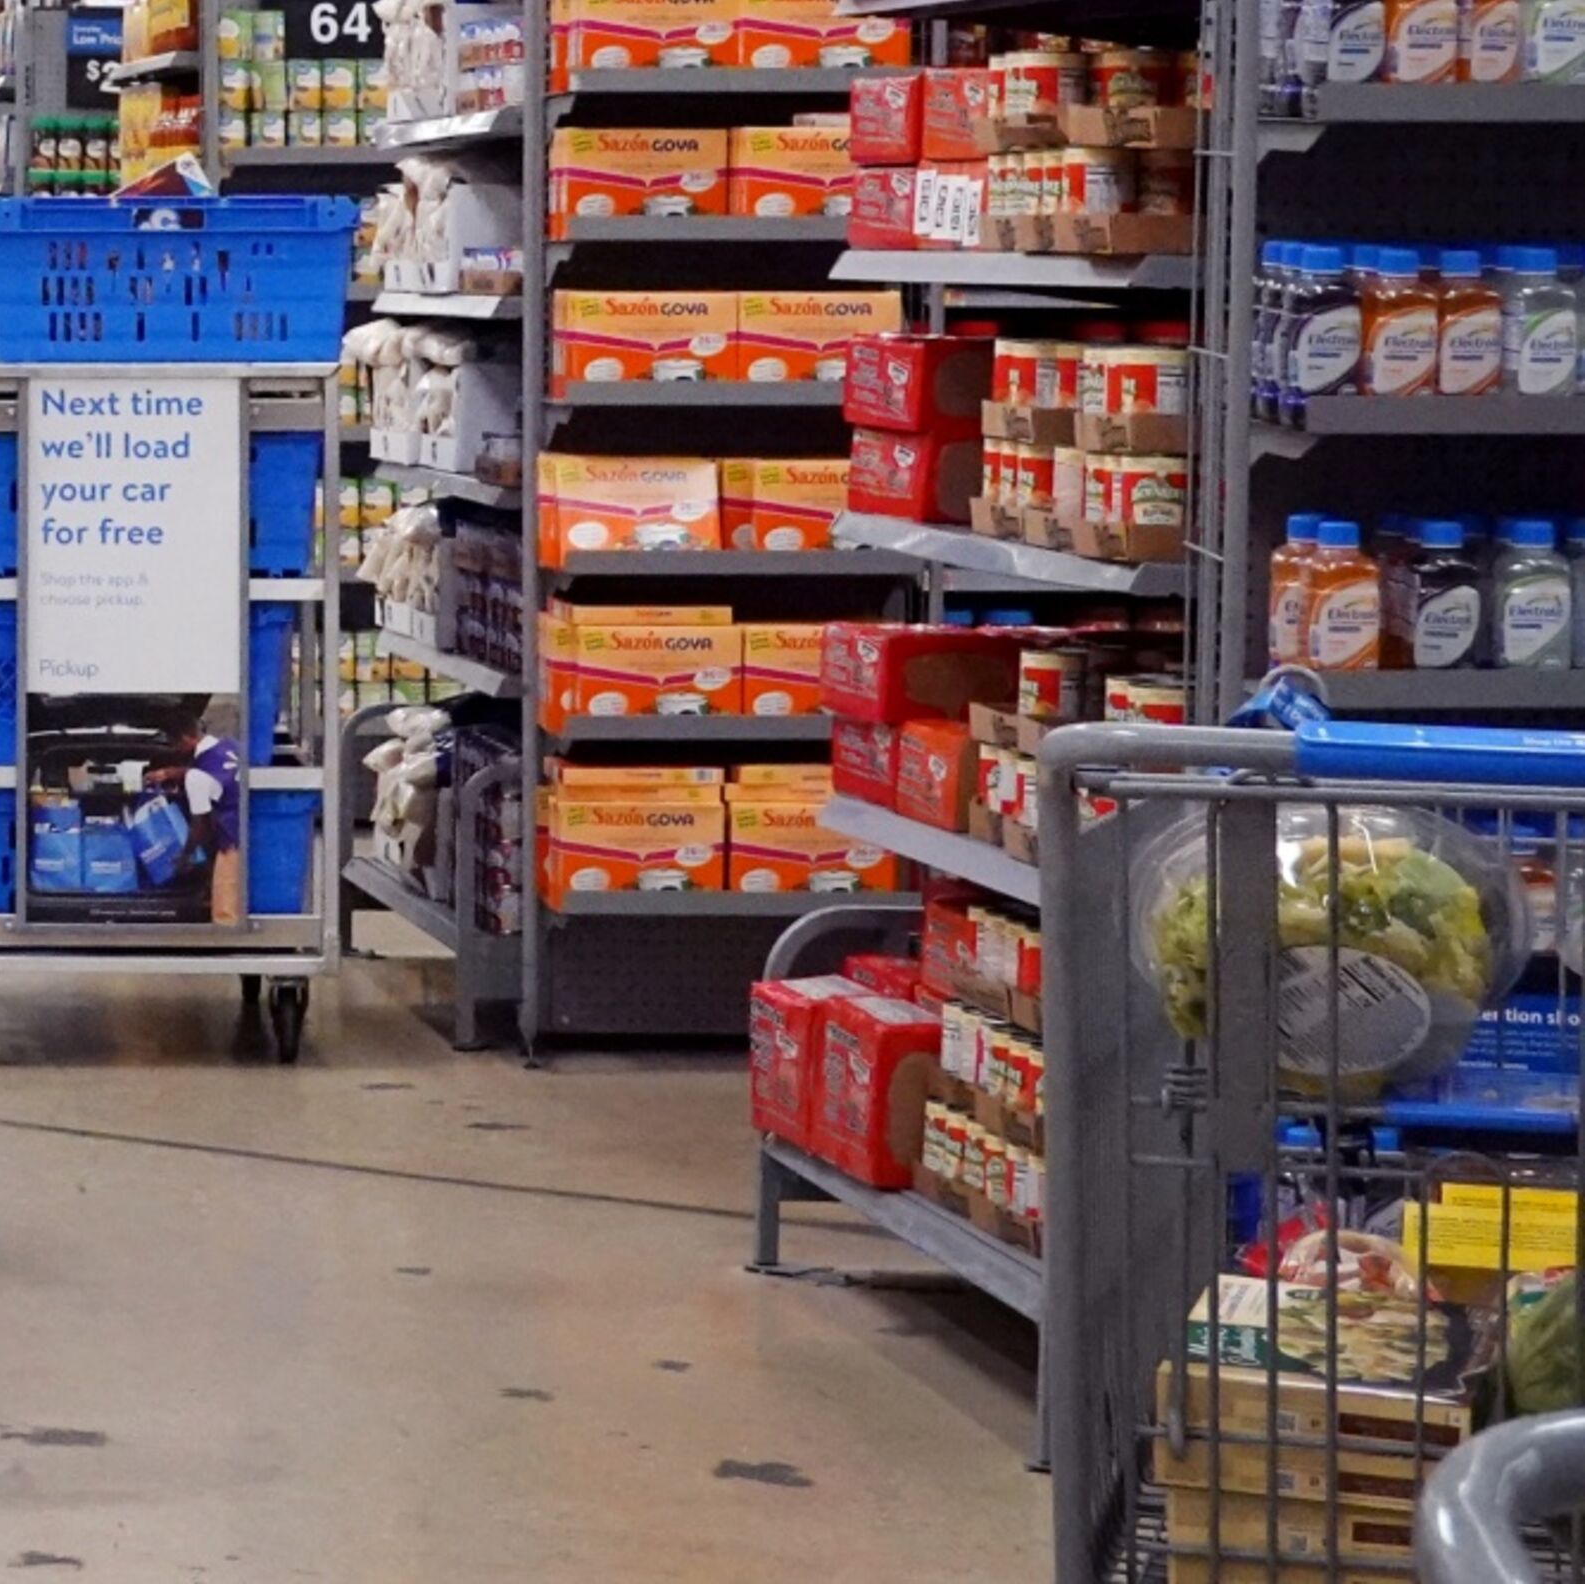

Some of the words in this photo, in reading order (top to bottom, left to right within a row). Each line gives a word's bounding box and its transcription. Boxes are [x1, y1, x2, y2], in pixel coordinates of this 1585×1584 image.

[309, 1, 372, 44] 64
[597, 132, 650, 152] Sazón
[605, 297, 659, 316] Sazón
[41, 389, 120, 417] Next
[130, 388, 205, 417] time
[41, 432, 113, 460] we'll
[123, 431, 191, 460] load
[41, 480, 111, 506] your
[123, 480, 171, 503] car
[41, 518, 89, 546] for
[98, 518, 165, 546] free
[611, 630, 664, 653] Sazón
[39, 659, 100, 680] Pickup
[591, 805, 646, 828] Sazón
